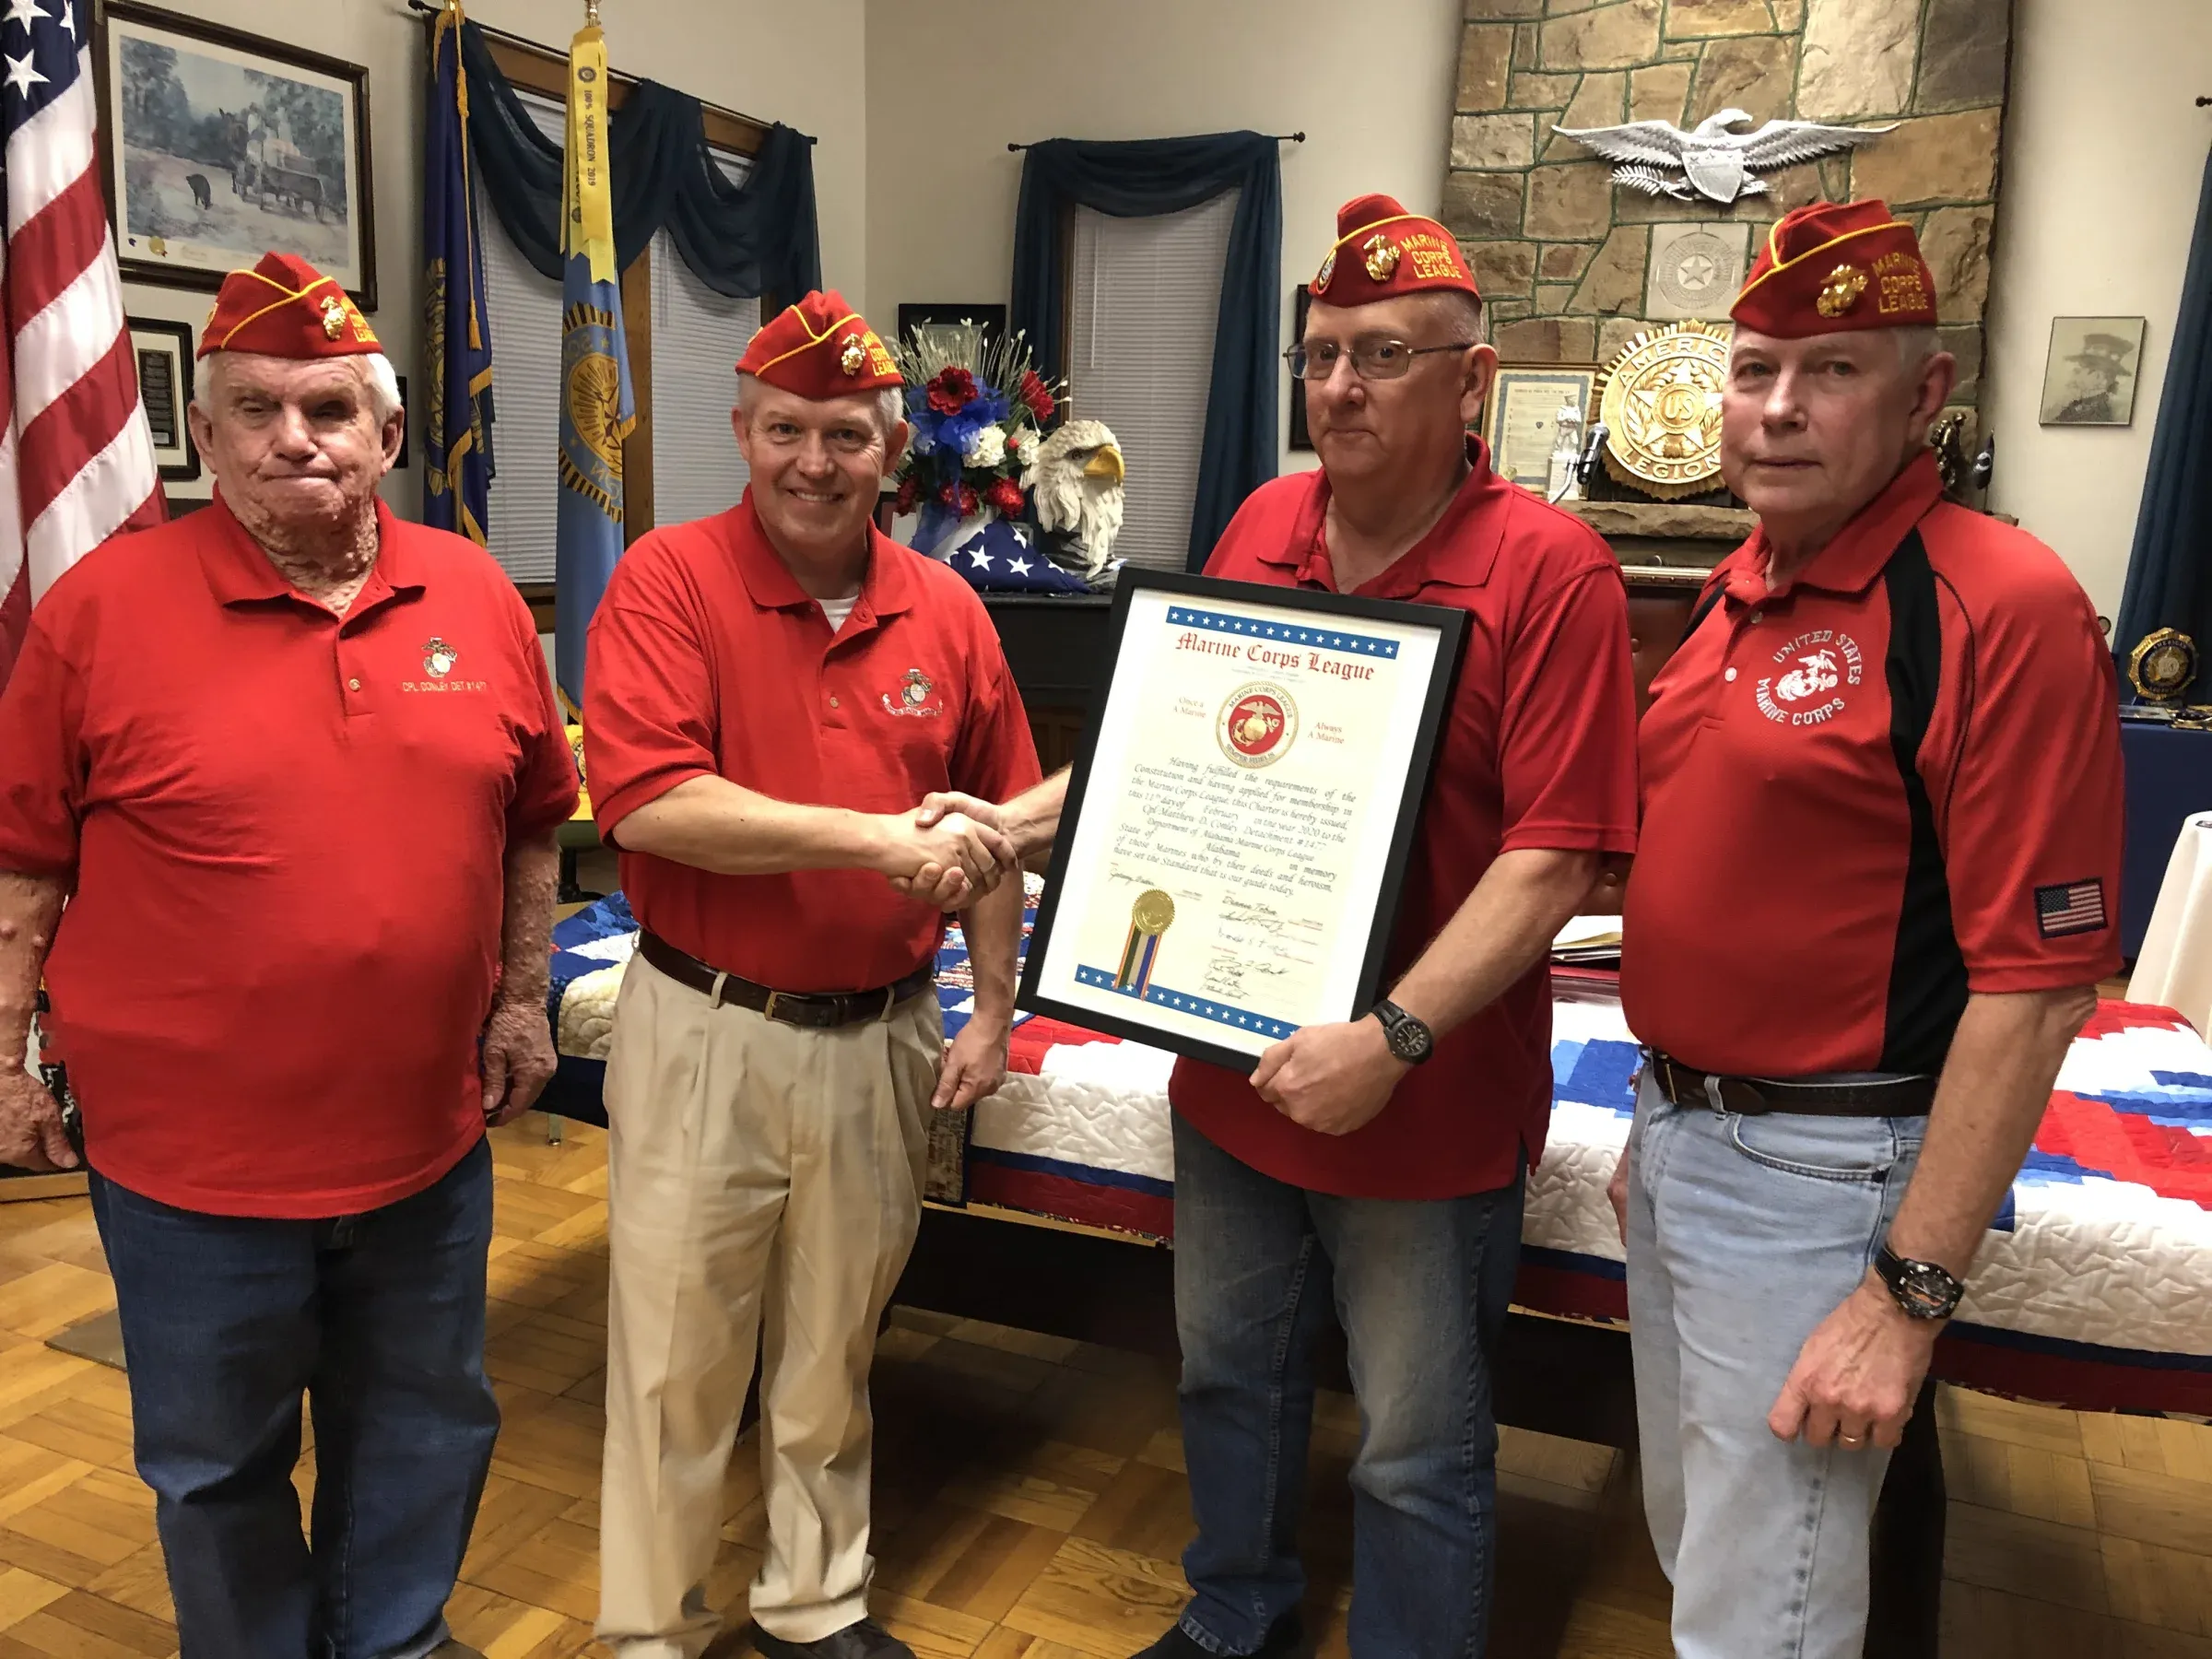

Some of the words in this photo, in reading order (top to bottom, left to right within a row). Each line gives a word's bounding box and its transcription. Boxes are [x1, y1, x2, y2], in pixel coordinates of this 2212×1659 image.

[583, 89, 593, 110] 100%
[584, 113, 595, 162] SQUADRON
[587, 166, 596, 186] 2019
[1400, 233, 1448, 255] MARINE
[1411, 251, 1453, 265] CORPS
[1414, 264, 1463, 279] LEAGUE
[1871, 252, 1921, 276] MARINE
[1880, 275, 1922, 294] CORPS
[1878, 293, 1928, 313] LEAGUE
[1618, 337, 1730, 387] AMERIC
[1175, 632, 1241, 658] Marine
[1247, 644, 1300, 669] Corps
[1308, 653, 1375, 680] League
[1772, 629, 1832, 664] UNITED
[1835, 633, 1862, 685] STATES
[1180, 706, 1206, 718] Marine
[1229, 688, 1253, 708] MARINE
[1254, 686, 1277, 696] CORPS
[1277, 692, 1294, 719] LEAGUE
[1756, 677, 1789, 724] MARINE
[1792, 698, 1845, 725] CORPS
[1314, 722, 1343, 734] Always
[1316, 732, 1345, 744] Marine
[1135, 764, 1184, 781] Constitution
[1187, 775, 1206, 785] and
[1207, 775, 1236, 794] having
[1239, 787, 1272, 798] applied
[1269, 791, 1287, 803] for
[1289, 798, 1339, 816] membership
[1169, 757, 1199, 772] Having
[1244, 772, 1258, 782] the
[1265, 779, 1318, 794] requirements
[1324, 788, 1337, 800] of
[1342, 792, 1356, 803] the
[1128, 790, 1143, 798] this
[1203, 805, 1239, 820] February
[1297, 825, 1321, 837] 2020
[1332, 832, 1346, 842] the
[1132, 776, 1144, 785] the
[1148, 779, 1175, 792] Marine
[1175, 785, 1197, 799] Corps
[1232, 797, 1247, 807] this
[1249, 801, 1280, 815] Charter
[1290, 808, 1317, 825] hereby
[1147, 817, 1189, 832] Department
[1189, 828, 1200, 838] of
[1200, 830, 1233, 843] Alabama
[1235, 837, 1263, 850] Marine
[1264, 844, 1286, 856] Corps
[1287, 849, 1315, 862] League
[1210, 819, 1237, 834] Conley
[1243, 826, 1293, 843] Detachment
[1113, 847, 1133, 856] have
[1147, 854, 1159, 863] the
[1160, 857, 1201, 873] Standard
[1200, 865, 1218, 877] that
[1242, 877, 1268, 889] guide
[1118, 823, 1141, 834] State
[1145, 829, 1155, 840] of
[1202, 842, 1241, 857] Alabama
[1303, 866, 1337, 882] memory
[1129, 837, 1149, 848] those
[1153, 842, 1187, 856] Marines
[1191, 853, 1209, 863] who
[1251, 864, 1274, 877] deeds
[1277, 873, 1297, 882] and
